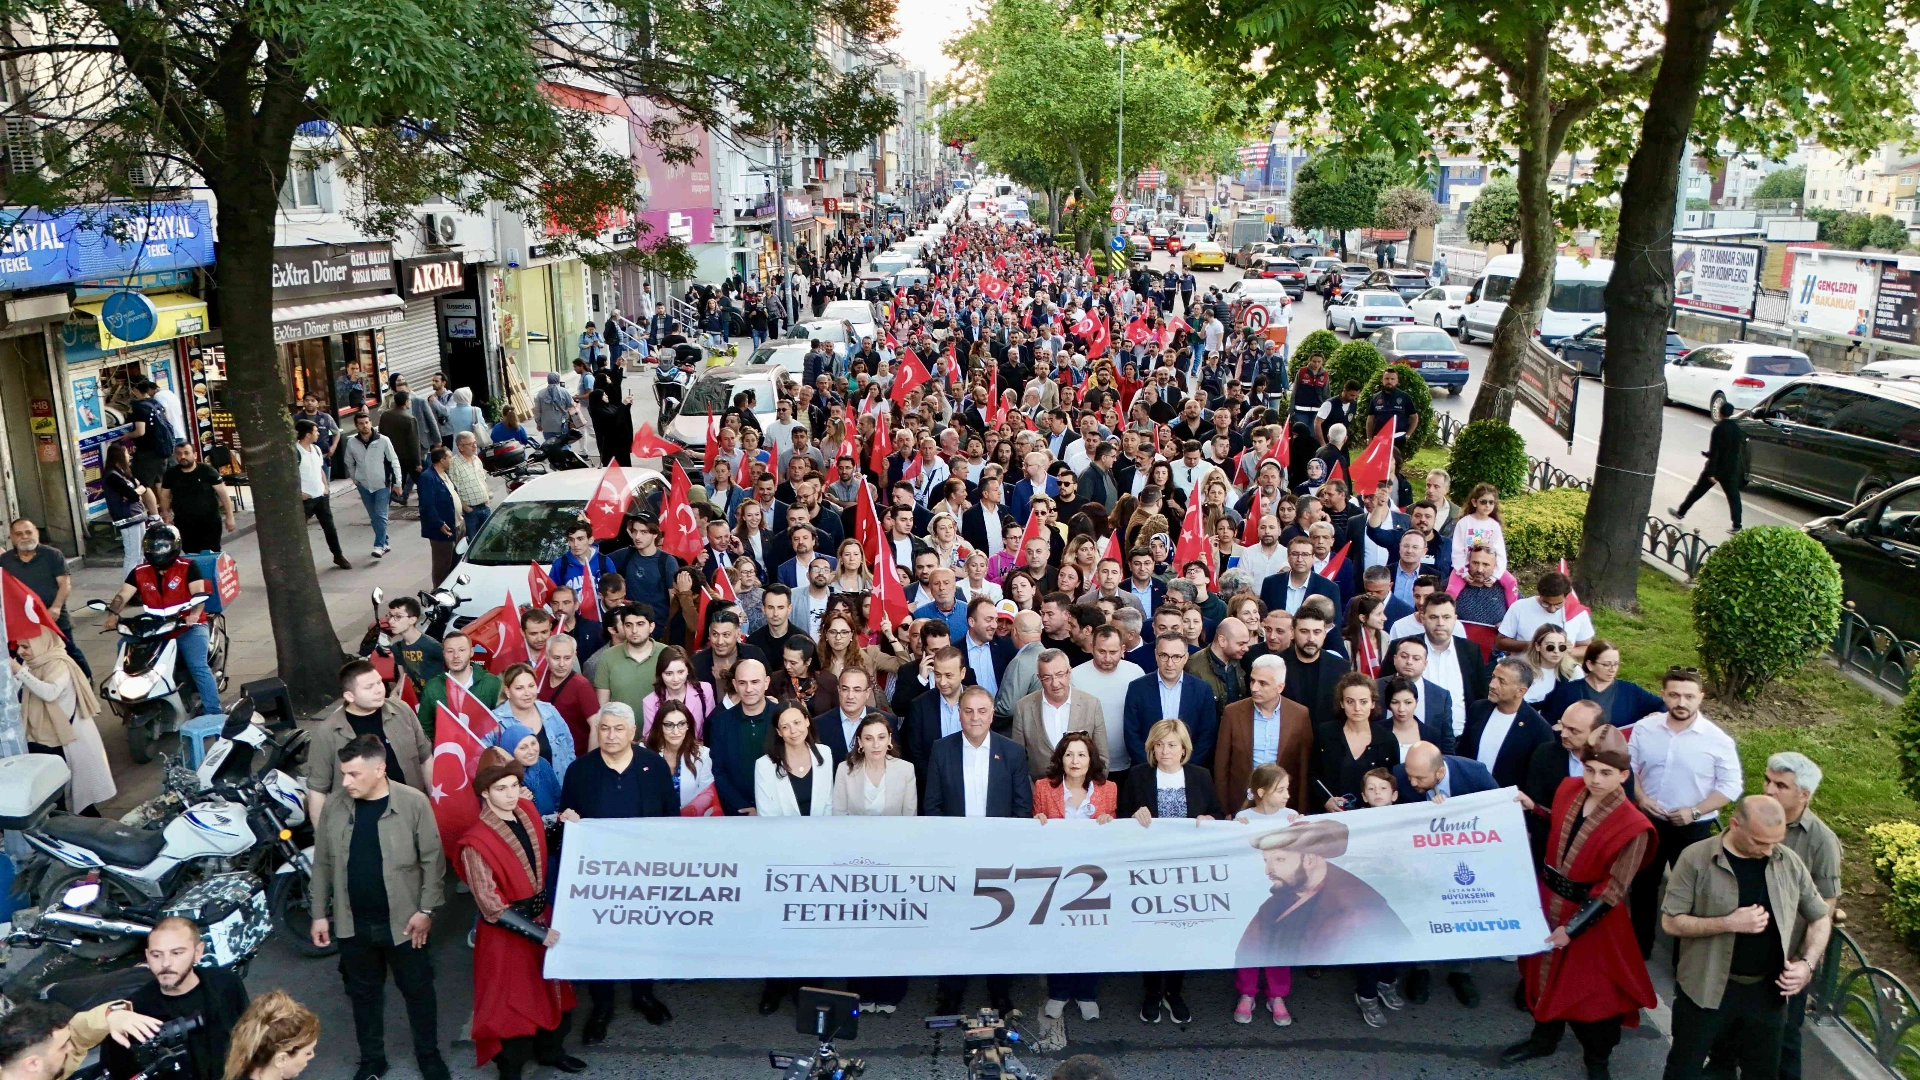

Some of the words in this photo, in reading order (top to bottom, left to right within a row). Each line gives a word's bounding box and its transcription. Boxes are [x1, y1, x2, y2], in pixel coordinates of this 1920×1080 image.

[1114, 210, 1124, 218] 30
[145, 243, 171, 258] TEKEL
[350, 250, 368, 267] ÖZEL
[368, 249, 390, 265] HATAY
[0, 256, 33, 274] TEKEL
[312, 260, 348, 284] Döner
[371, 265, 391, 281] DÖNER
[1701, 264, 1715, 279] SPOR
[412, 260, 463, 294] AKBAL
[1817, 279, 1858, 295] GENÇLERİN
[1815, 294, 1856, 311] BAKANLIĞI
[304, 321, 330, 336] Döner
[1429, 816, 1480, 832] Umut
[1412, 830, 1502, 848] BURADA
[577, 855, 738, 878] İSTANBUL'UN
[1128, 864, 1229, 886] KUTLU
[764, 868, 957, 893] İSTANBUL'UN
[569, 883, 741, 902] MUHAFIZLARI
[970, 863, 1111, 931] 572
[1441, 891, 1496, 901] BÜYÜKŞEHİR
[782, 898, 928, 922] FETHİ'NİN
[1131, 892, 1231, 915] OLSUN
[592, 905, 714, 926] YÜRÜYOR
